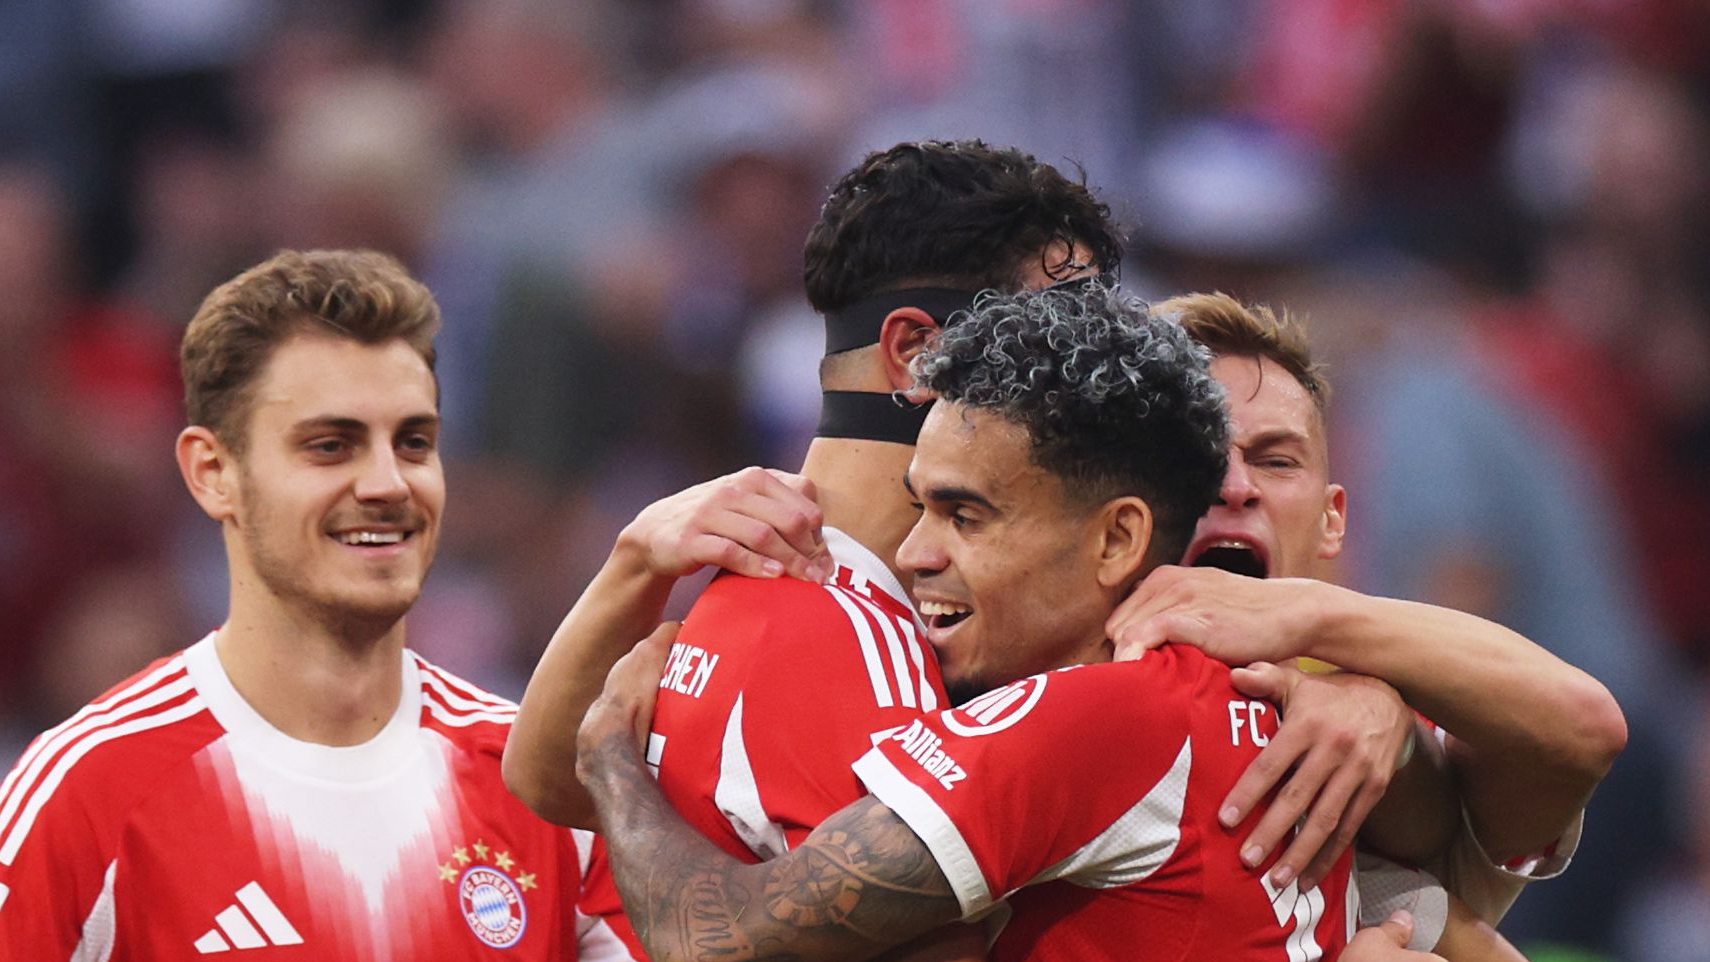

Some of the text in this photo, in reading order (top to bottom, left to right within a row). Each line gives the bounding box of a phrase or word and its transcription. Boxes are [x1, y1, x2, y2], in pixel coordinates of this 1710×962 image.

[660, 643, 720, 698] CHEN
[1228, 700, 1270, 747] FC
[891, 718, 968, 791] Allianz
